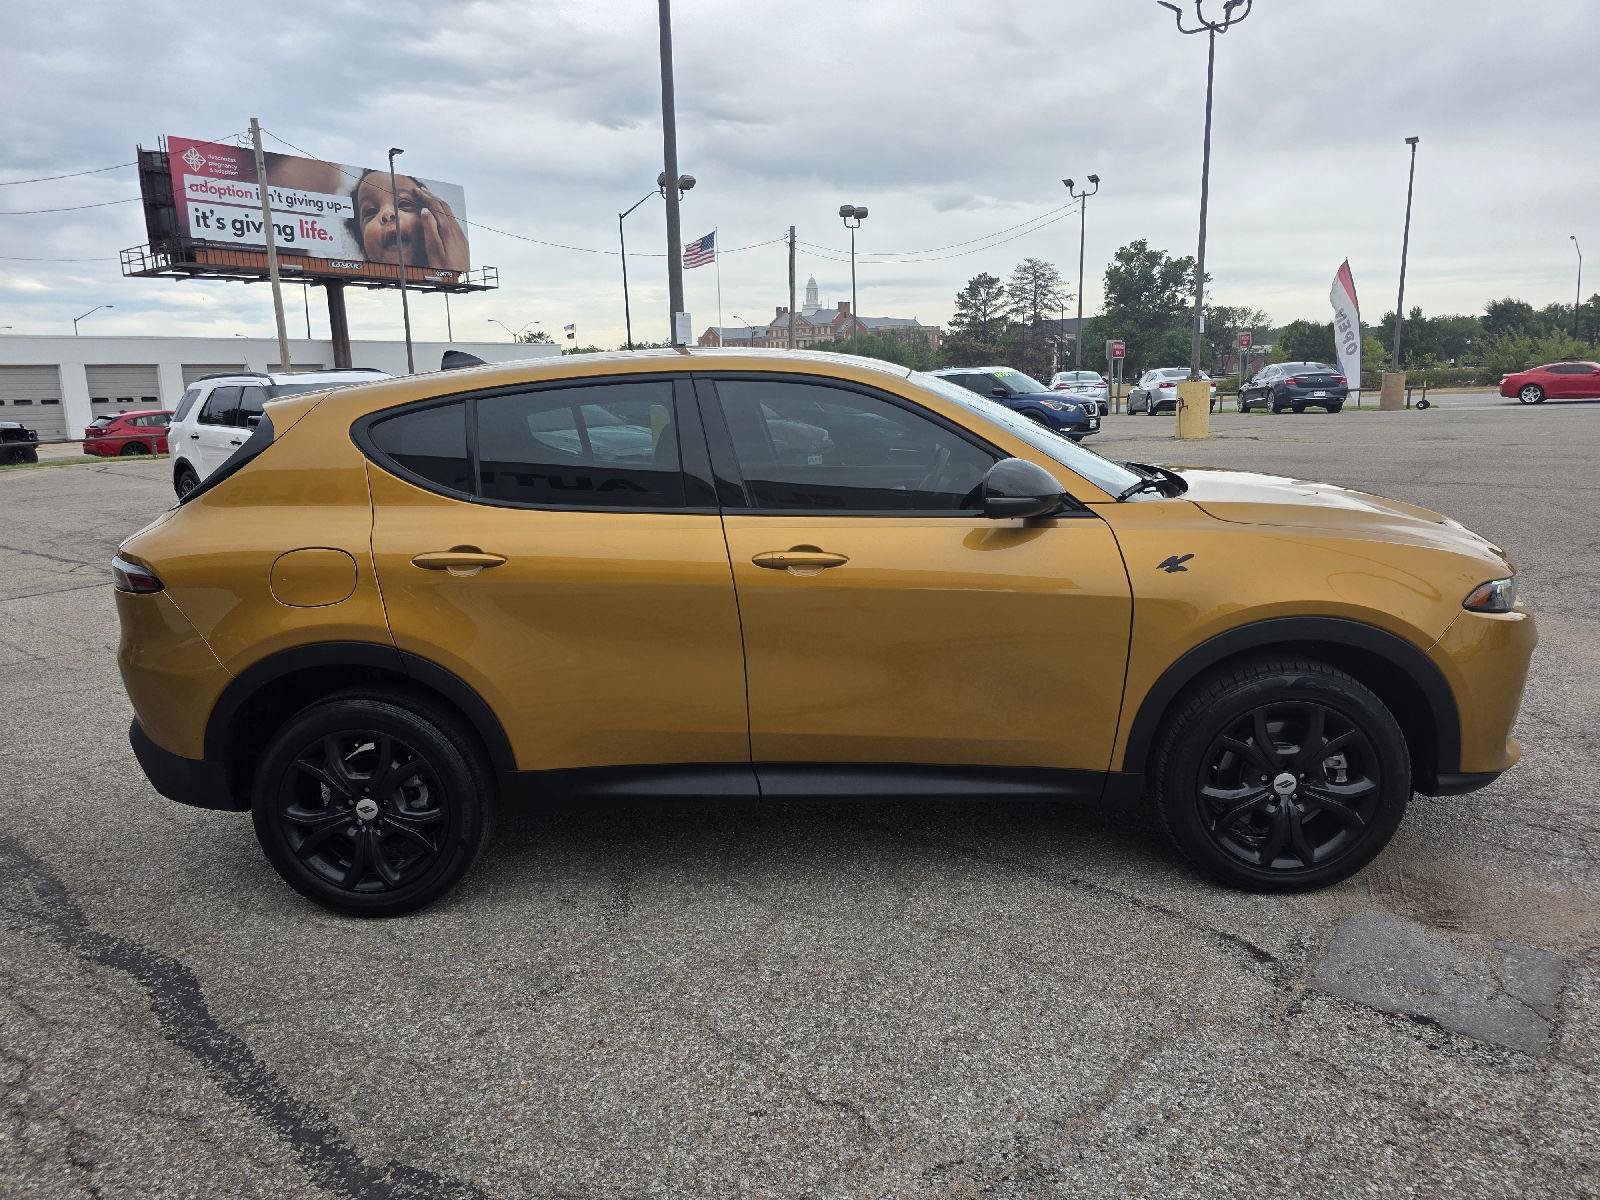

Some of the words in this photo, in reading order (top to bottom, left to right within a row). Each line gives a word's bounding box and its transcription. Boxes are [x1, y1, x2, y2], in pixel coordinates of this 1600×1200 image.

[189, 181, 253, 199] adoption
[255, 187, 283, 204] in't
[286, 193, 324, 212] giving
[194, 207, 227, 231] it's
[231, 213, 296, 243] givng
[299, 218, 334, 241] life.
